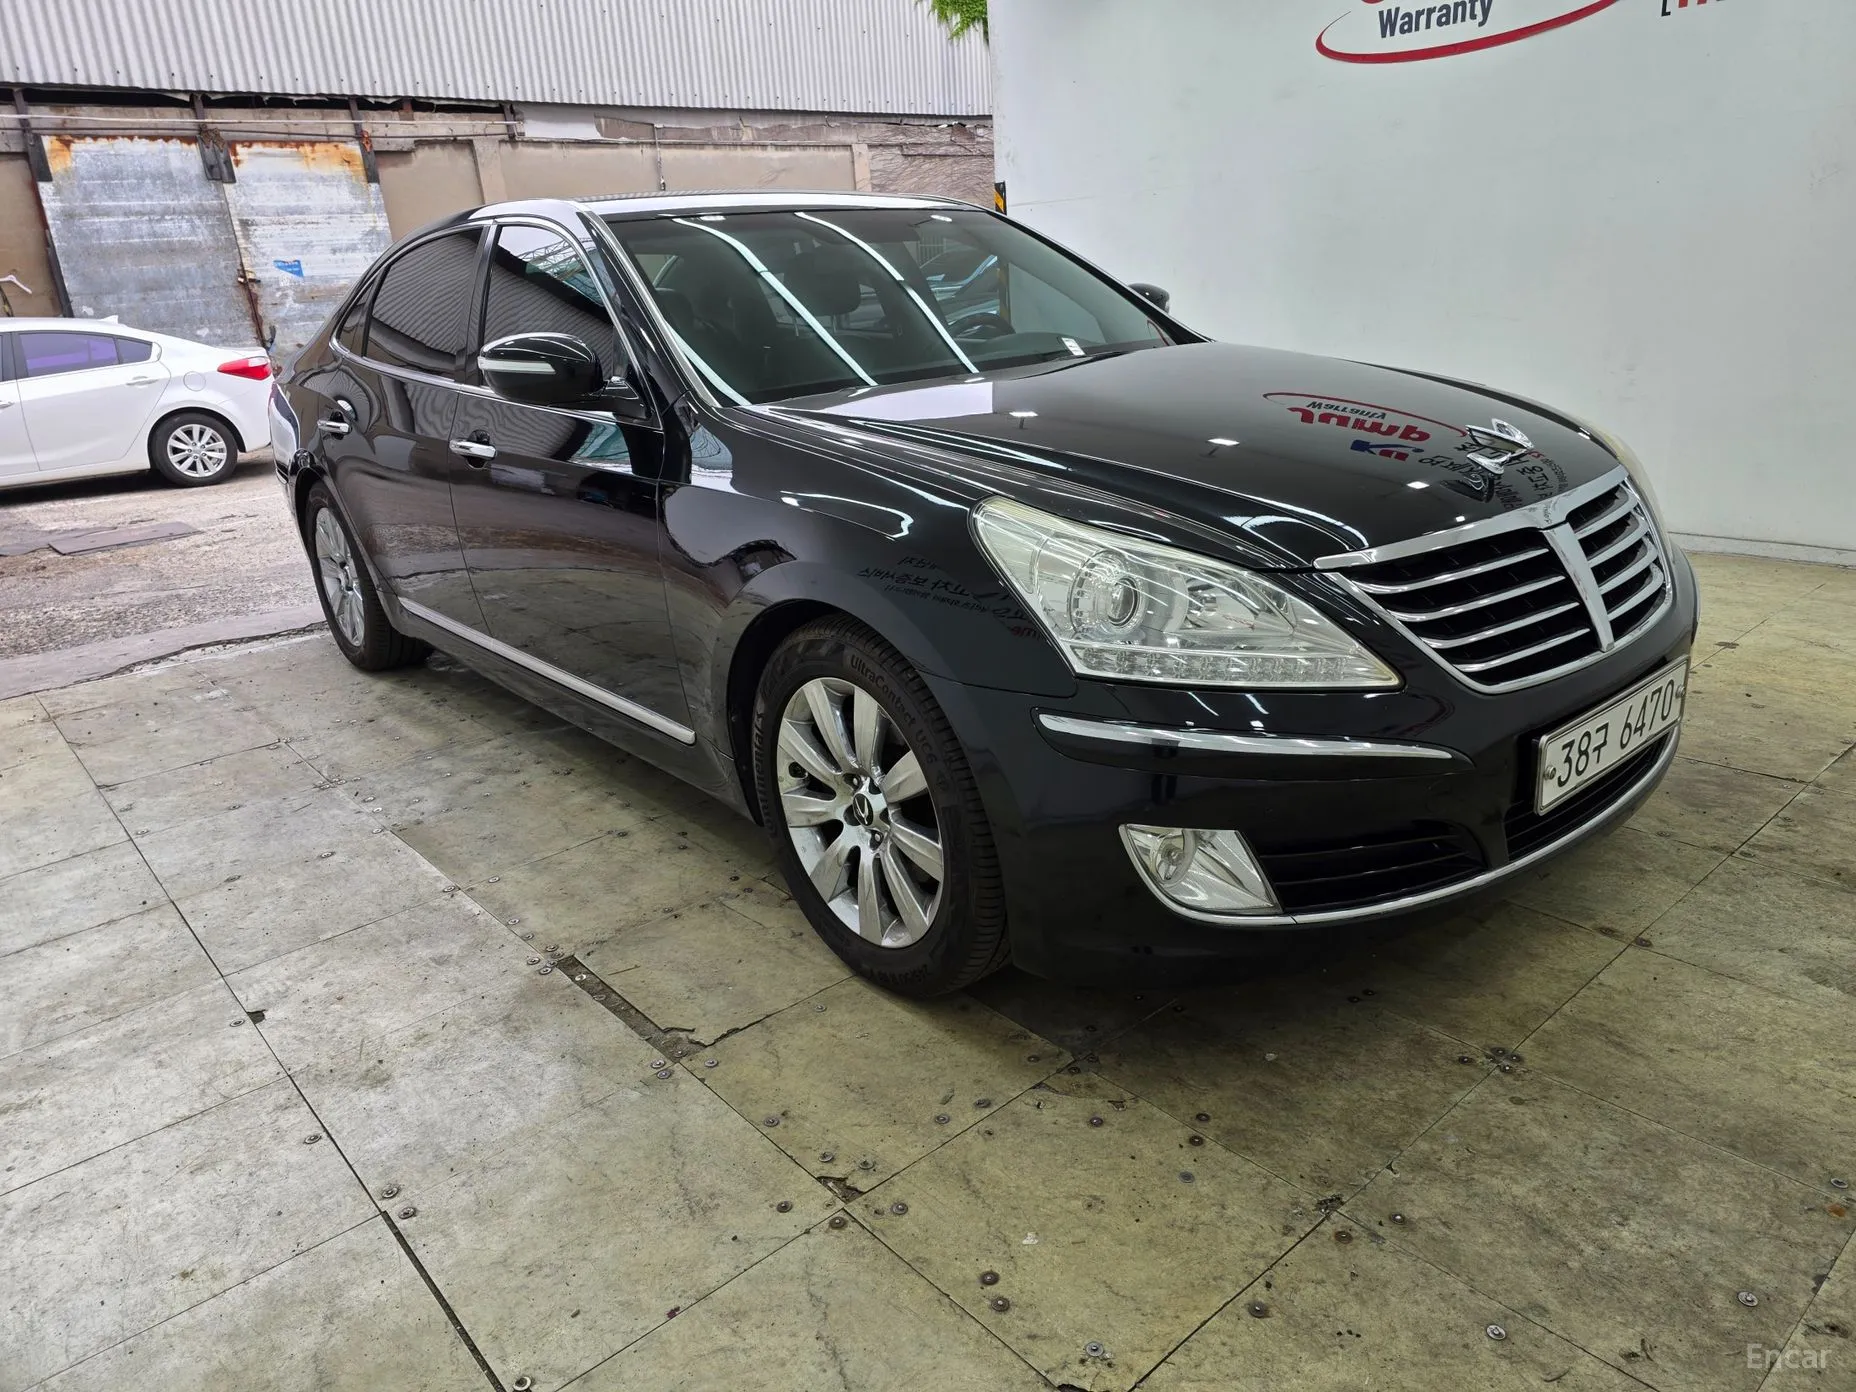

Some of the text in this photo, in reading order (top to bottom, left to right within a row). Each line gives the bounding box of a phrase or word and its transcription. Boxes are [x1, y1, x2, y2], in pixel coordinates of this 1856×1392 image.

[1378, 0, 1494, 39] Warranty
[1557, 678, 1676, 789] 38구 6470
